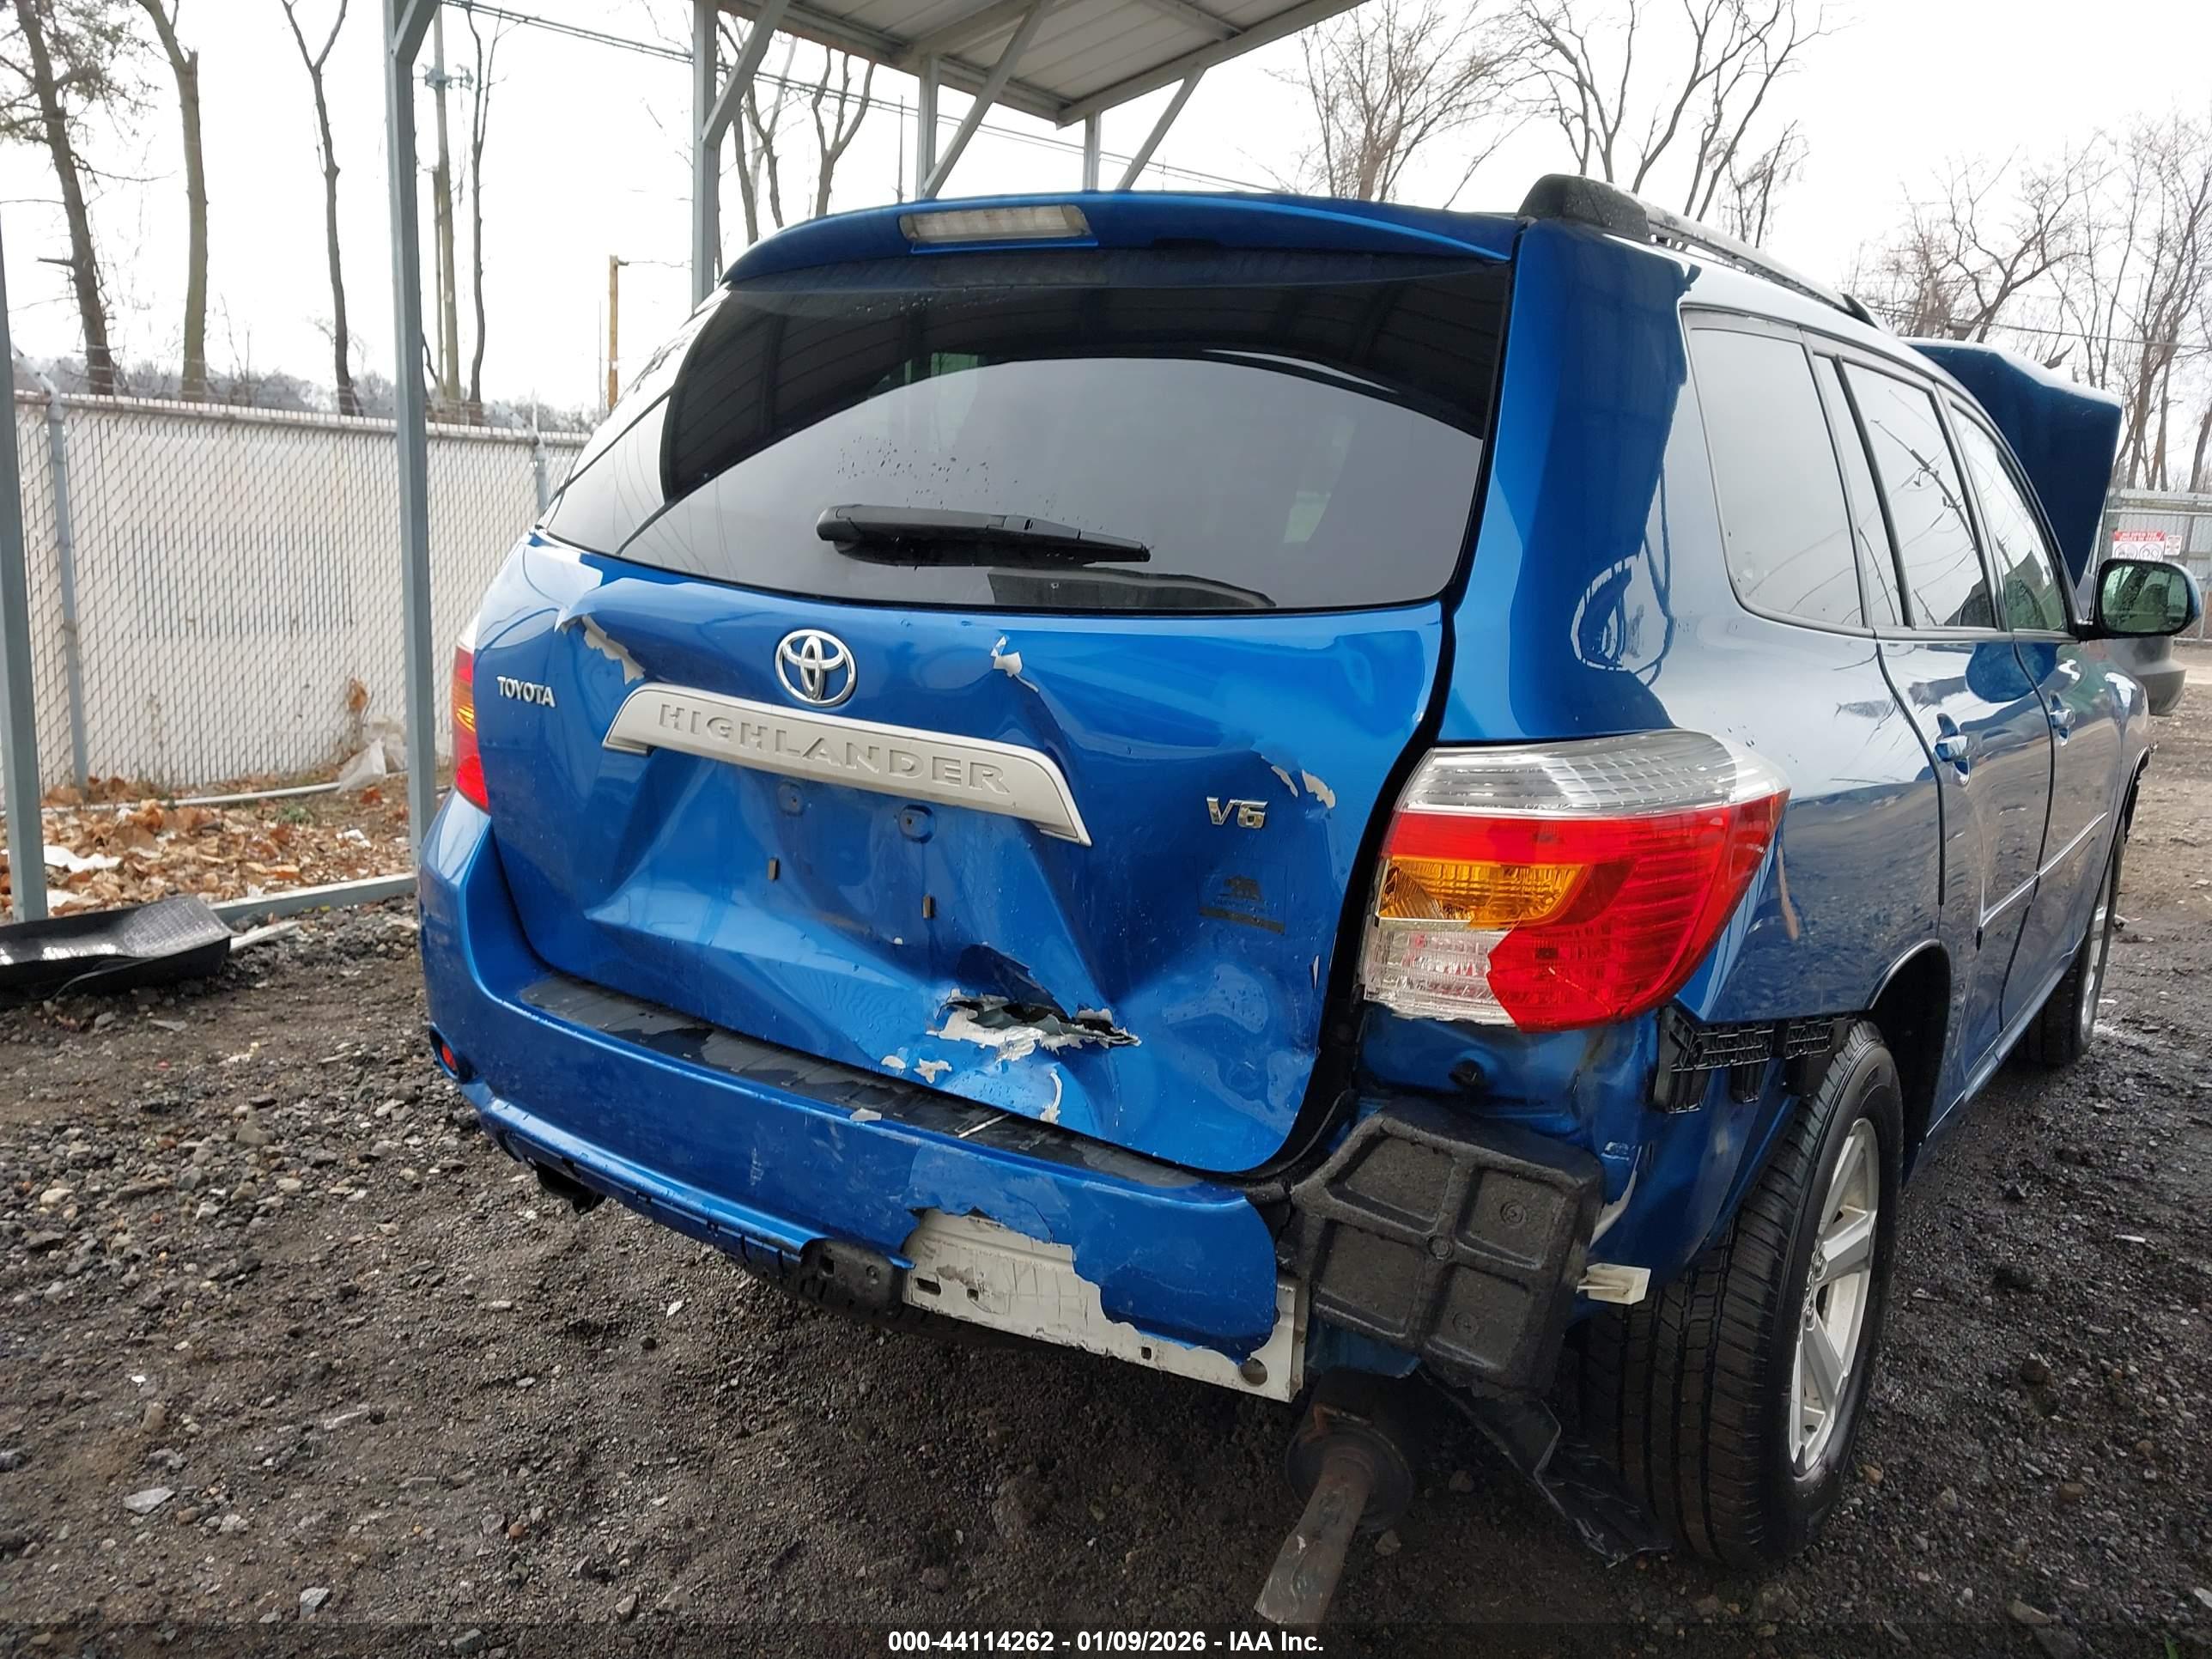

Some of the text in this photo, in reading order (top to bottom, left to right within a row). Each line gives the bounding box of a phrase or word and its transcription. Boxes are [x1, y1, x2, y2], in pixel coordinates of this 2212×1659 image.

[496, 675, 556, 708] TOYOTA
[658, 702, 1012, 794] HIGHLANDER
[1206, 796, 1268, 829] V6
